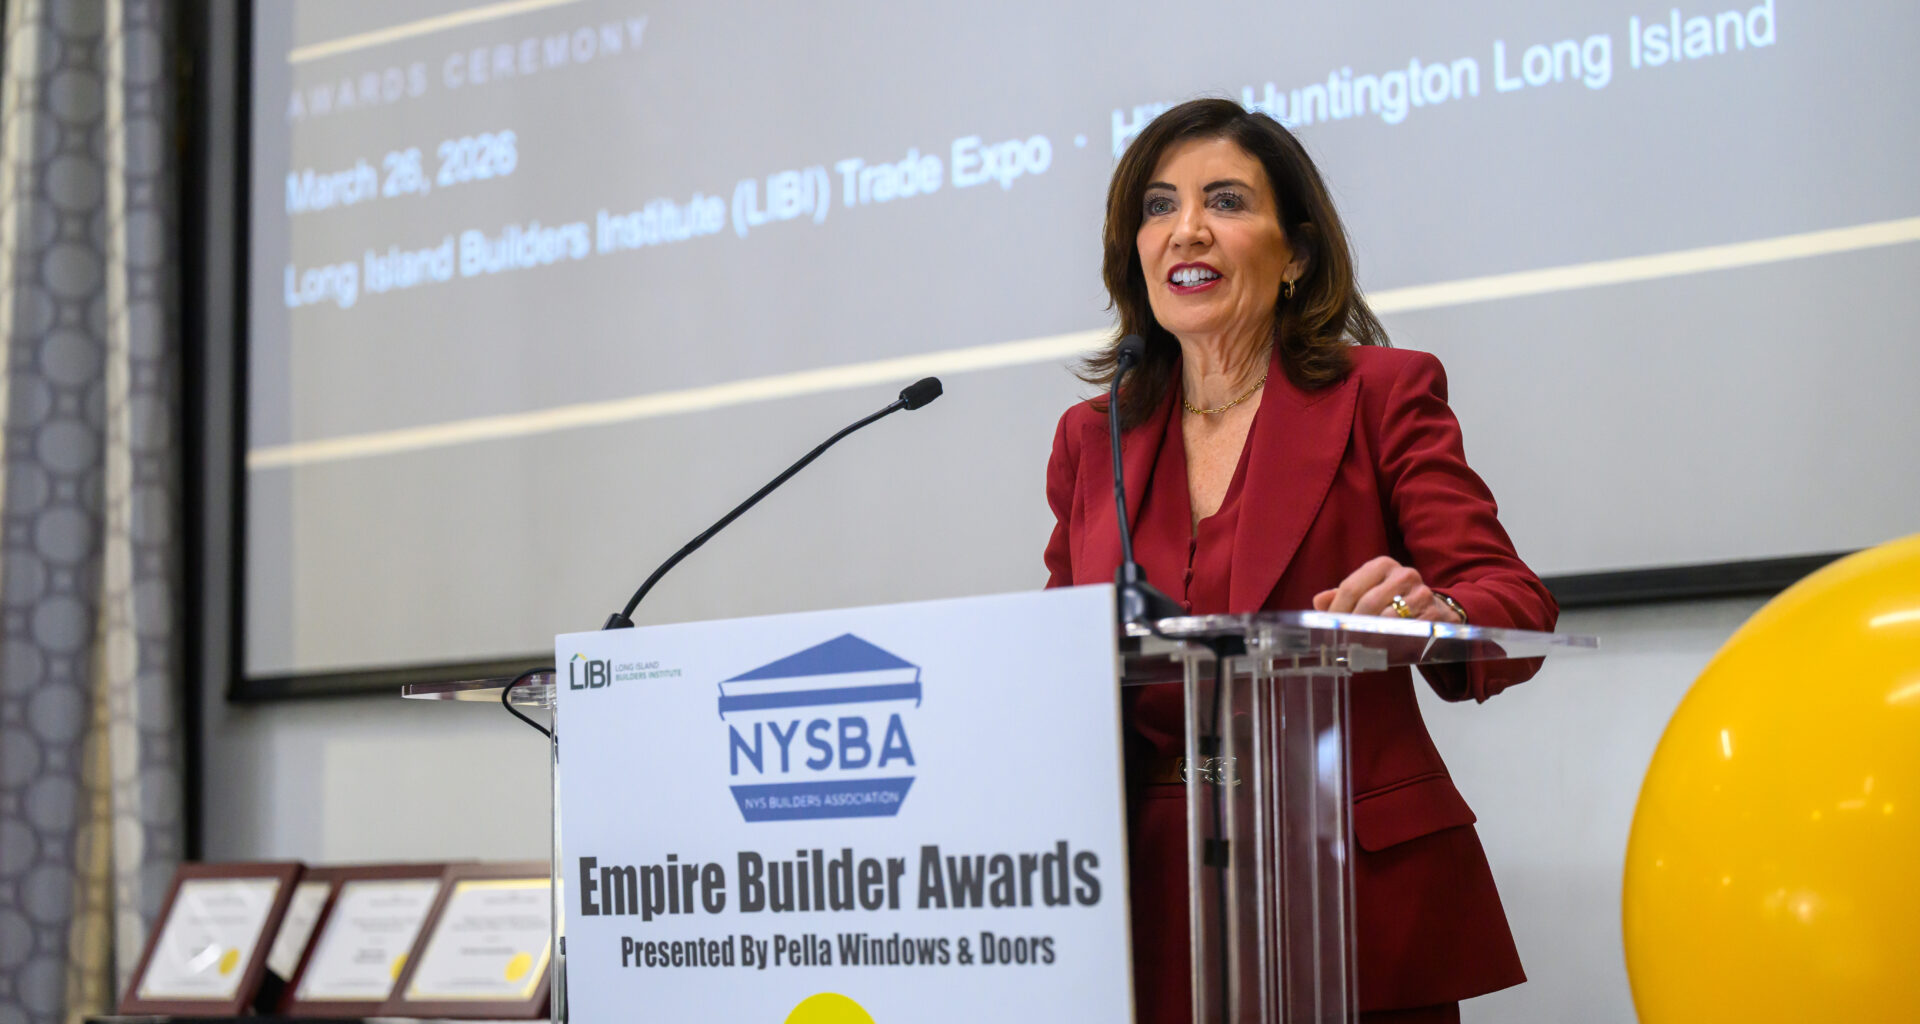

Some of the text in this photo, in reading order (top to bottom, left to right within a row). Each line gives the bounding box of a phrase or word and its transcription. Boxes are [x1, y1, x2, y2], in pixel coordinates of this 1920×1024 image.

[445, 17, 648, 88] CEREMONY
[1493, 34, 1612, 90] Long
[1629, 0, 1776, 69] Island
[286, 129, 518, 215] March 26, 2026
[284, 134, 1052, 309] Long Island Builders Institute (LIBI) Trade Expo
[570, 659, 611, 690] LIBI
[615, 661, 659, 672] LONG ISLAND
[615, 669, 682, 681] BUILDERS INSTITUTE
[729, 713, 916, 776] NYSBA
[744, 790, 899, 809] NYS BUILDERS ASSOCIATION
[578, 840, 1102, 922] Empire Builder Awards
[621, 931, 1055, 970] Presented By Pella Windows & Doors
